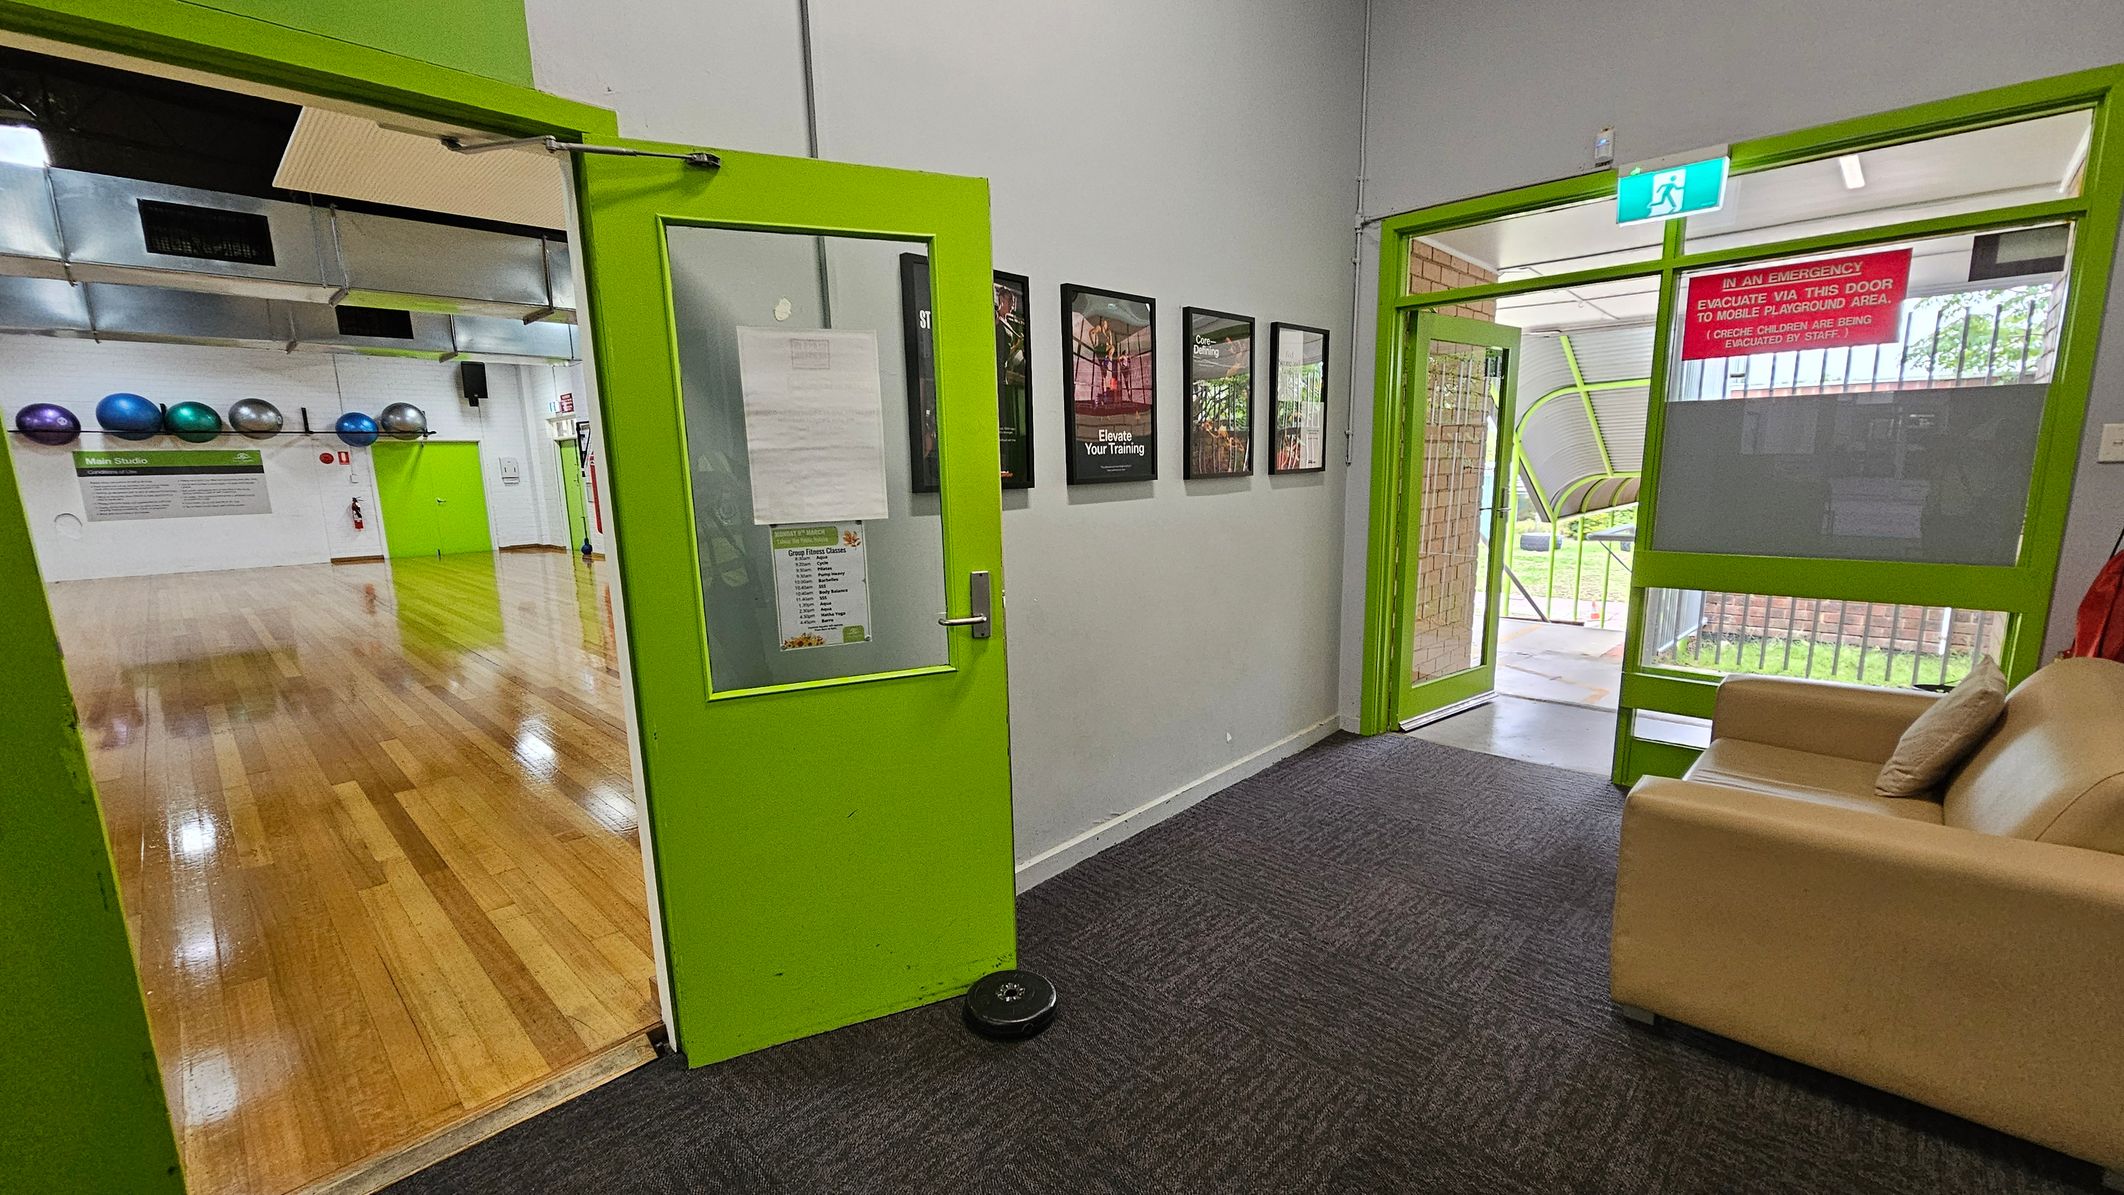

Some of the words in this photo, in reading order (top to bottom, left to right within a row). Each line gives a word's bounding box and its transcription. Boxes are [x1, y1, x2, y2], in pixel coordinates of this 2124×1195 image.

[1722, 278, 1736, 288] IN
[1742, 274, 1763, 286] AN
[1768, 261, 1863, 283] EMERGENCY
[1698, 293, 1767, 310] EVACUATE
[1774, 290, 1798, 302] VIA
[1804, 284, 1840, 298] THIS
[1844, 278, 1894, 294] DOOR
[1696, 312, 1713, 322] TO
[1716, 306, 1760, 320] MOBILE
[1764, 298, 1846, 316] PLAYGROUND
[1850, 293, 1892, 307] AREA.
[1714, 326, 1754, 339] CRECHE
[1757, 322, 1808, 335] CHILDREN
[1812, 318, 1834, 330] ARE
[1838, 315, 1872, 326] BEING
[1725, 336, 1782, 348] EVACUATED
[1786, 334, 1800, 342] BY
[1193, 344, 1220, 358] Defining
[1098, 429, 1132, 442] Elevate
[1084, 442, 1108, 455] Your
[1108, 442, 1145, 456] Training
